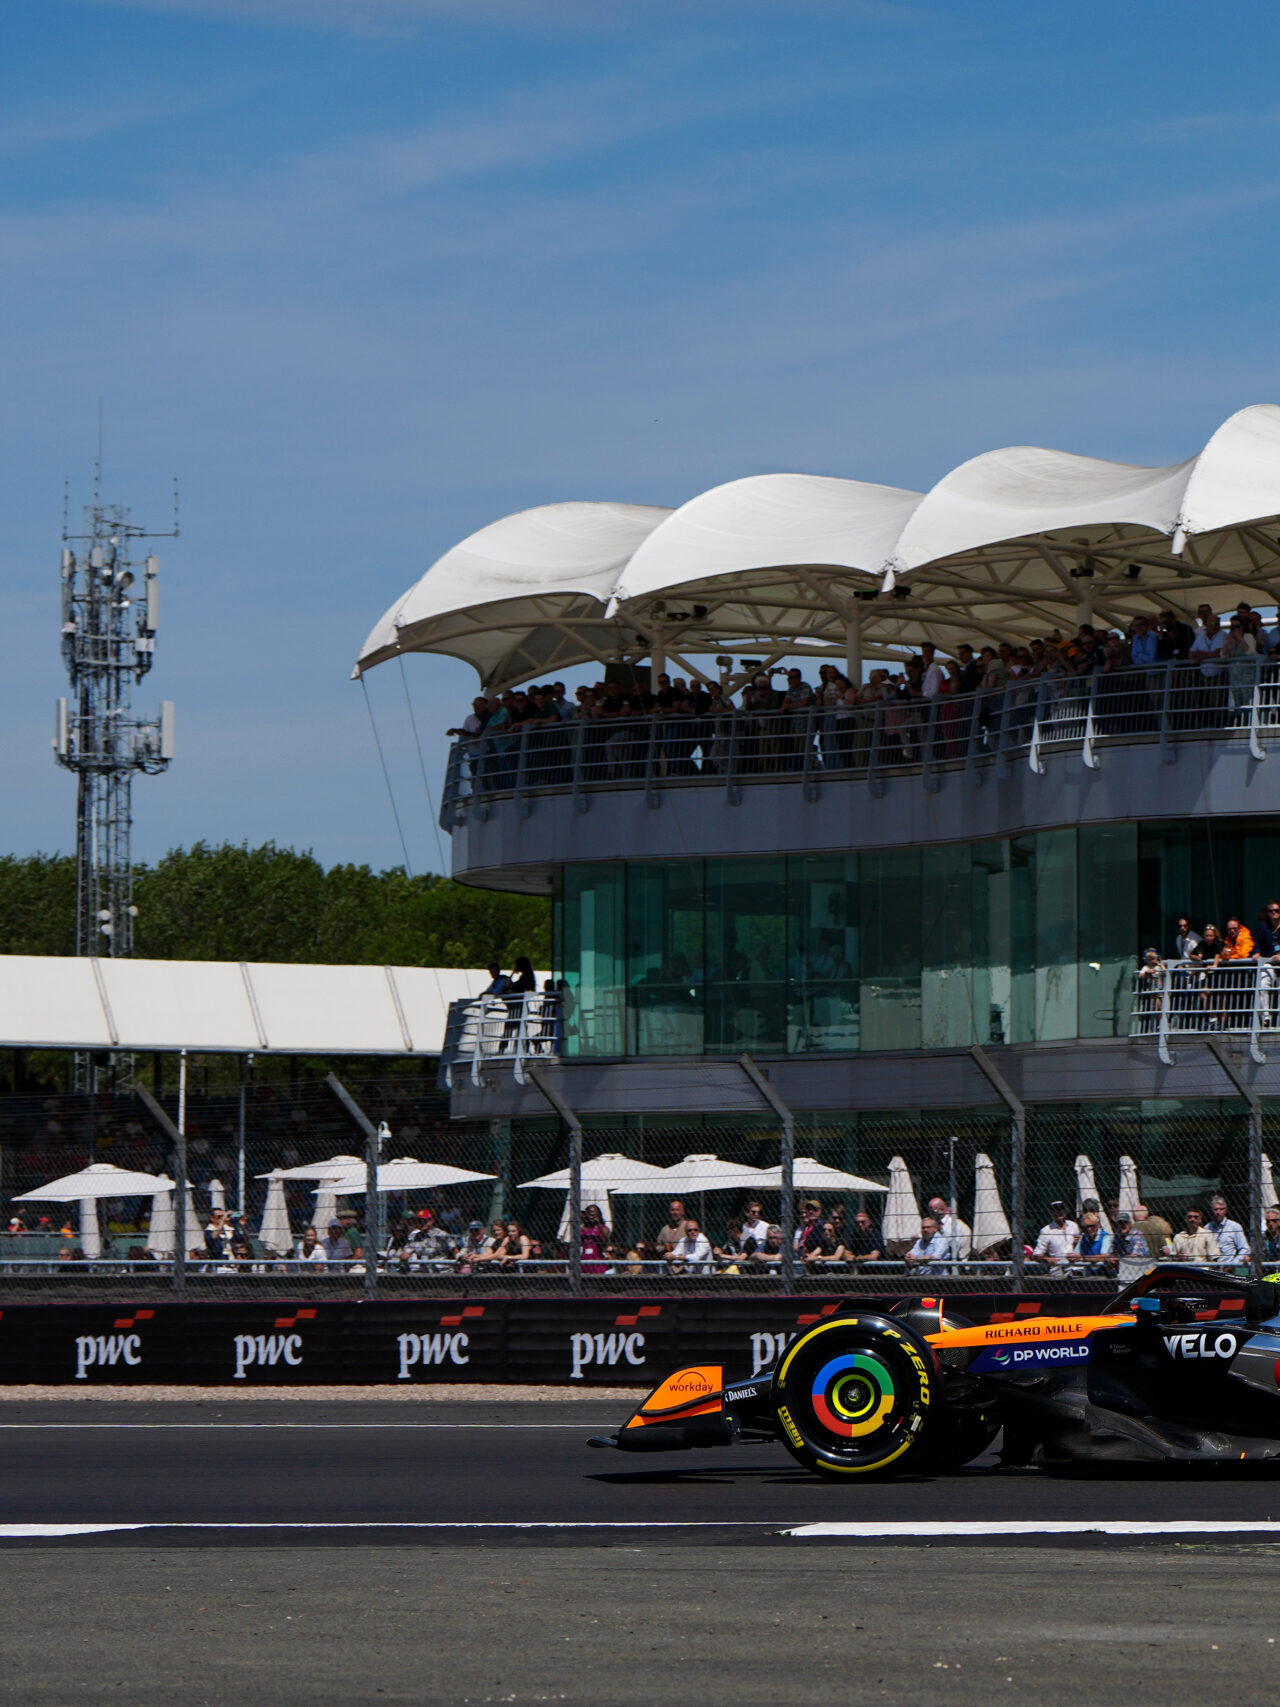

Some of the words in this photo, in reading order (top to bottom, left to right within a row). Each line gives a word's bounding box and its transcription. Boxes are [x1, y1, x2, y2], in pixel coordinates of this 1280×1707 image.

[985, 1326, 1041, 1339] RICHARD
[1045, 1323, 1083, 1334] MILLE
[1013, 1350, 1034, 1362] DP
[1036, 1346, 1089, 1360] WORLD
[1162, 1333, 1237, 1359] VELO
[75, 1333, 142, 1379] pwc
[233, 1333, 303, 1379] pwc
[397, 1332, 470, 1379] pwc
[570, 1332, 646, 1379] pwc
[749, 1332, 798, 1378] pw
[882, 1329, 901, 1339] P
[900, 1342, 930, 1406] ZERO
[669, 1381, 714, 1394] workday
[777, 1405, 805, 1449] PIRELLI
